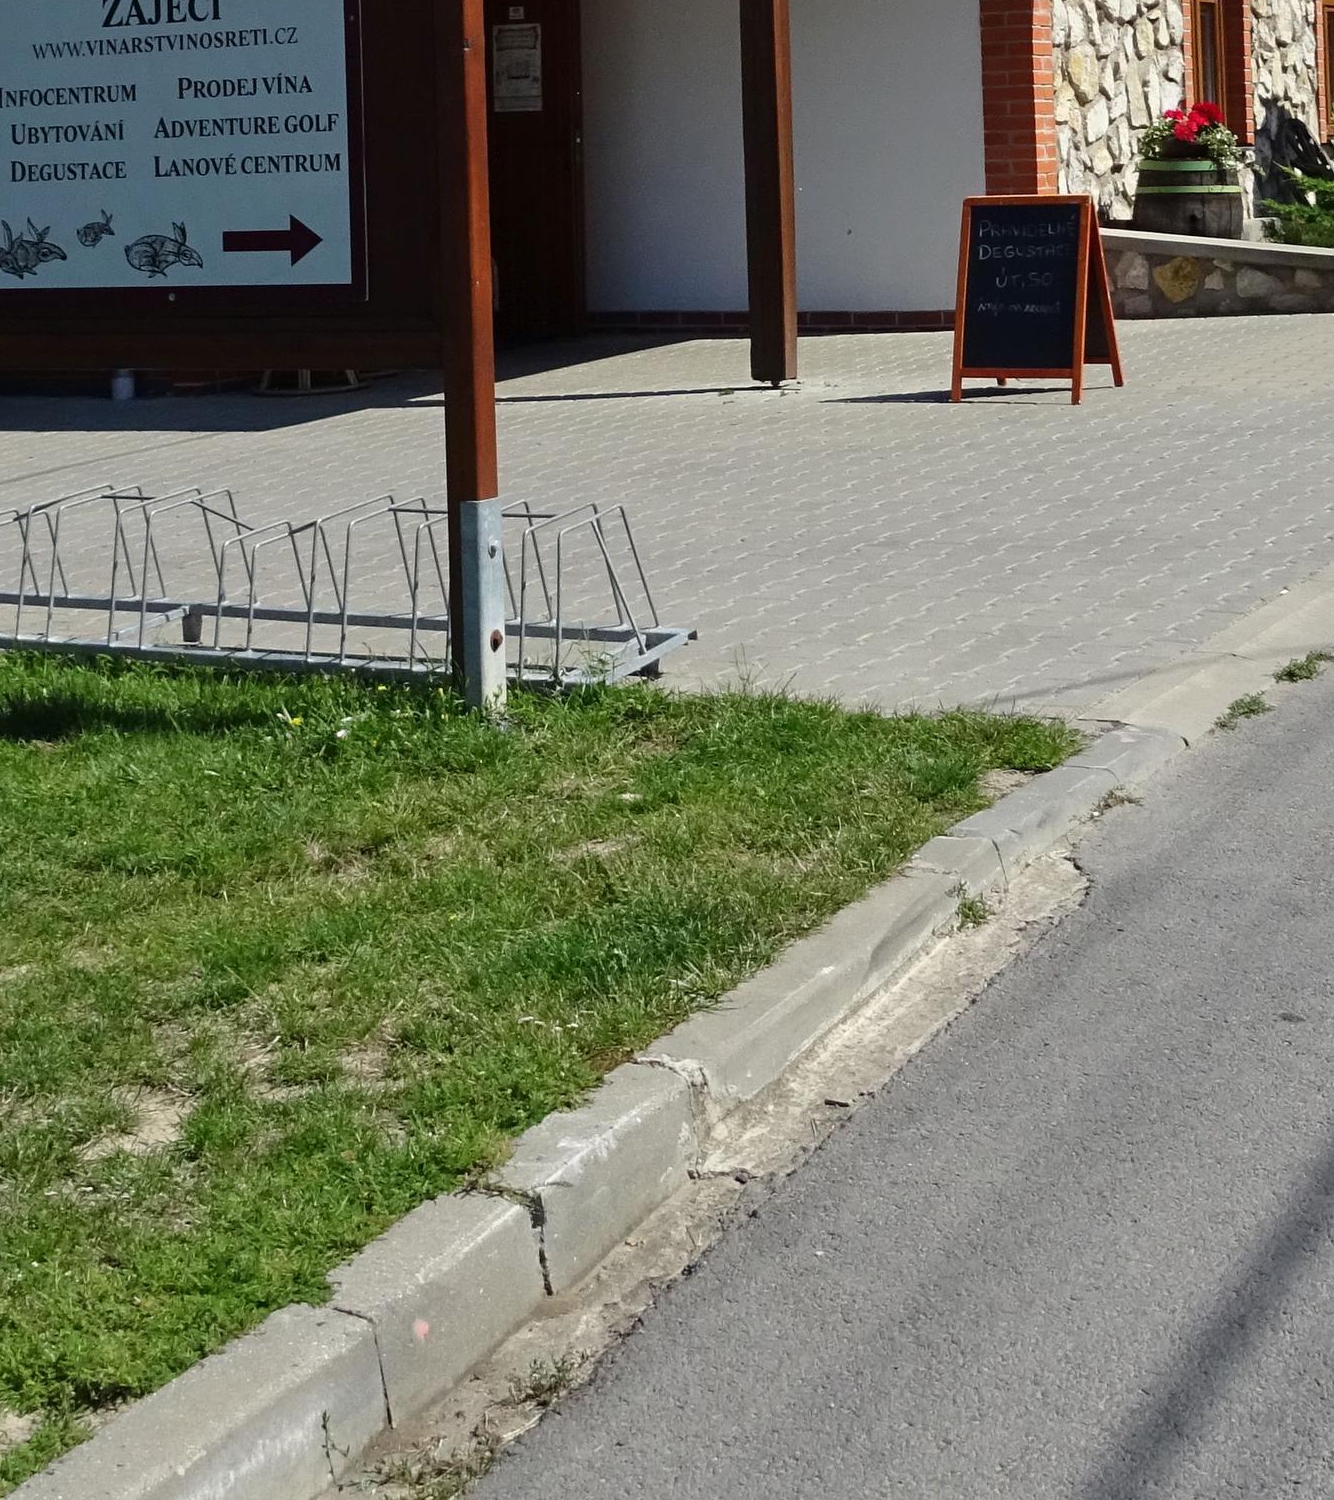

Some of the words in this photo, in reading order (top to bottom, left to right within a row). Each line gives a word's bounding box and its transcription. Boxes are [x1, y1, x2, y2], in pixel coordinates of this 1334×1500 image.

[32, 26, 299, 60] WWW.VINARSTVINOSRETI.CZ
[177, 77, 258, 100] PRODEJ
[262, 73, 313, 95] VÍNA
[154, 115, 281, 139] ADVENTURE
[284, 113, 340, 134] GOLF
[10, 160, 127, 183] DEGUSTACE
[154, 153, 237, 178] LANOVÉ
[240, 153, 341, 174] CENTRUM
